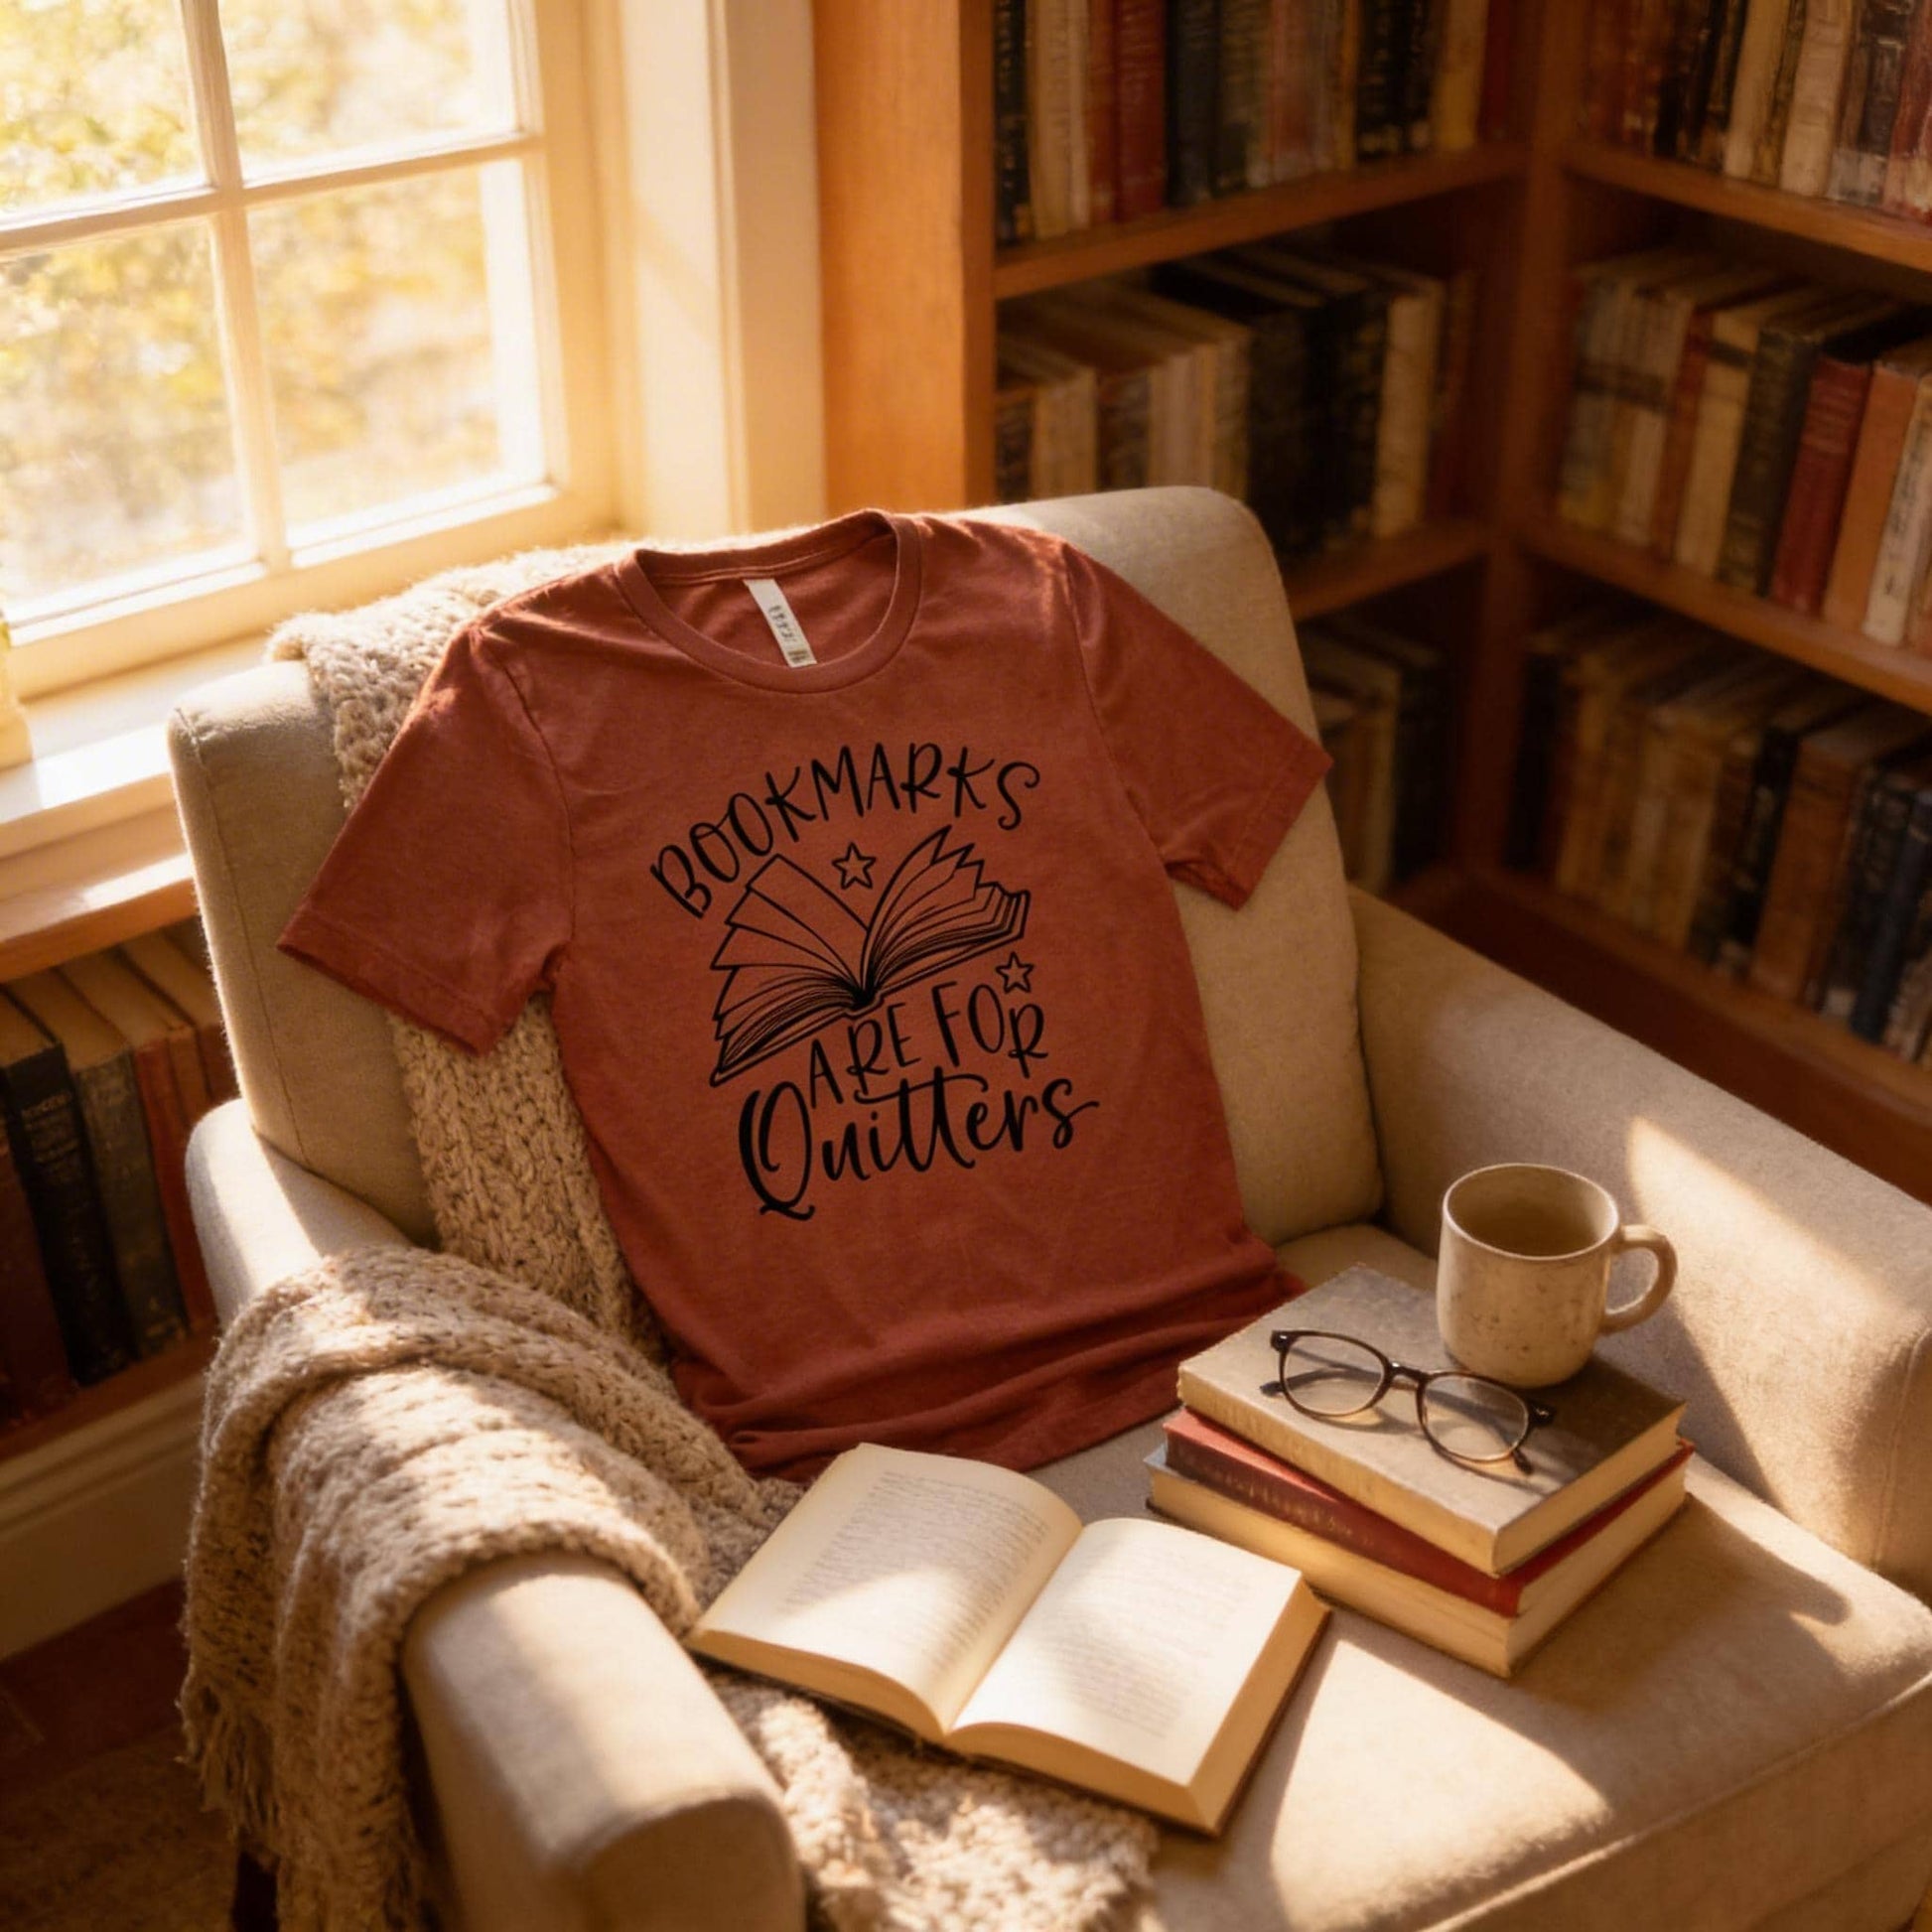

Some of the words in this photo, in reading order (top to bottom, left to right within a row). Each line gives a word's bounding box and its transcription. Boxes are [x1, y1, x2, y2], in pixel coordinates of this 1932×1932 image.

[650, 743, 1040, 919] BOOKMARKS
[810, 1002, 921, 1109] ARE
[931, 980, 1048, 1078] FOR
[738, 1065, 1100, 1221] Quitters
